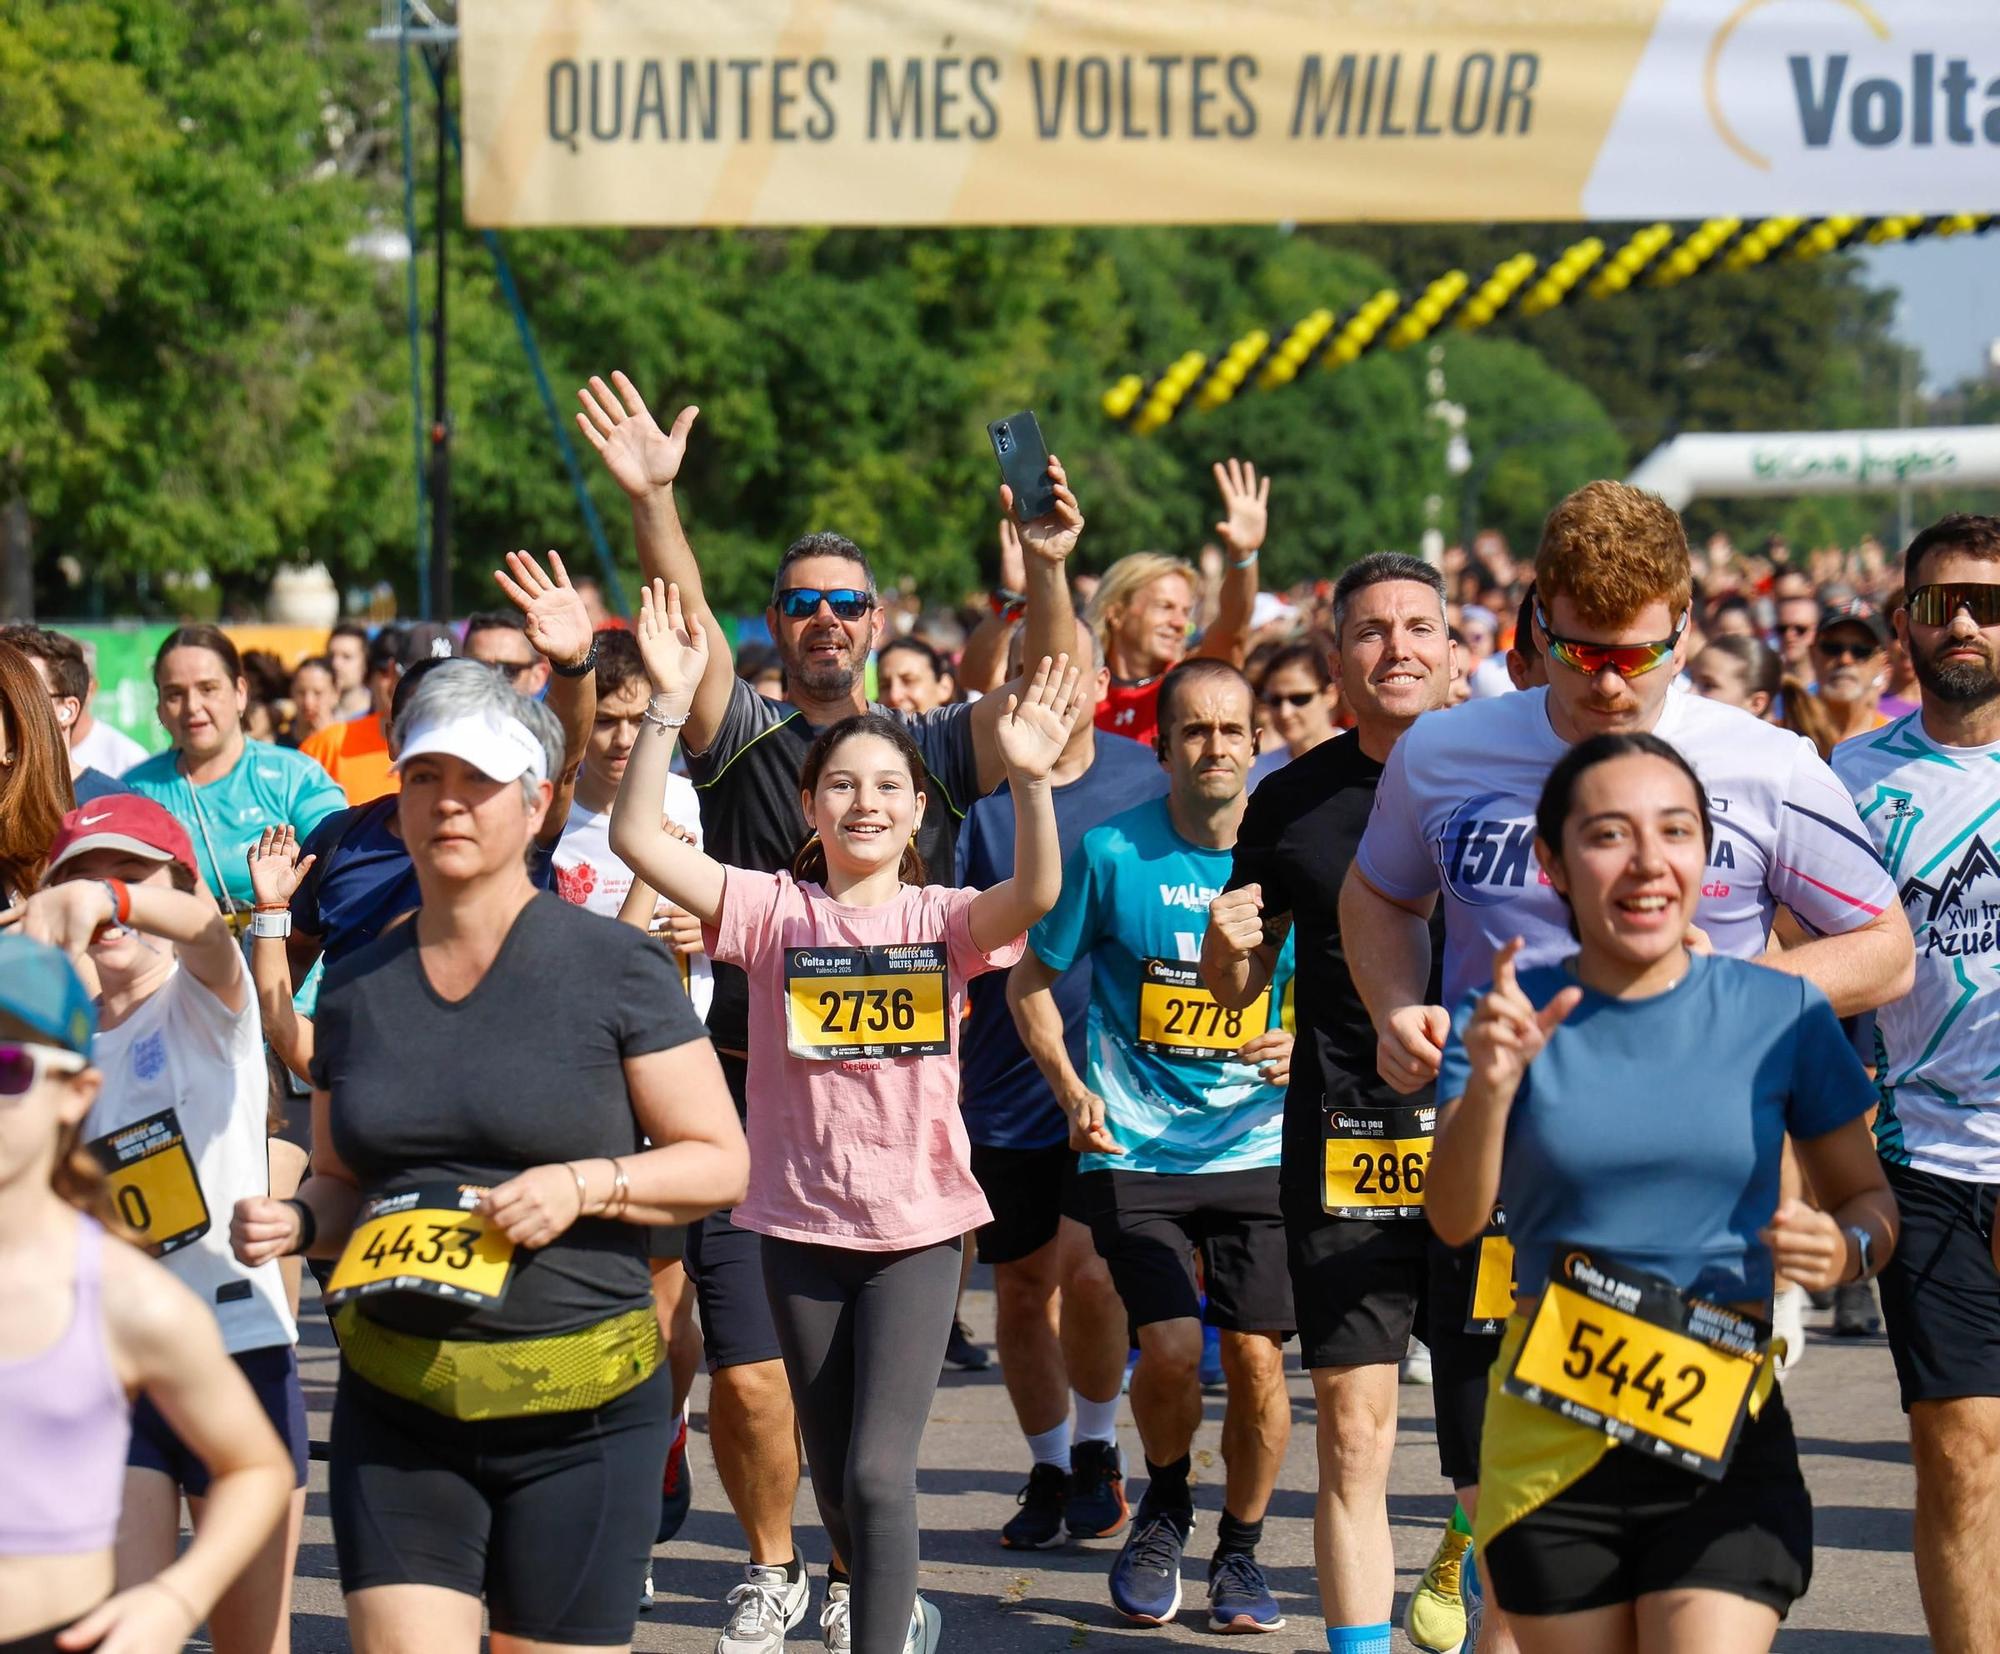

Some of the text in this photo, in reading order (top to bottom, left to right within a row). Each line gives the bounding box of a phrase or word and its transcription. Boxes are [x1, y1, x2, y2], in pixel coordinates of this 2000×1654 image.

[548, 33, 1541, 154] QUANTES MÉS VOLTES MILLOR
[1947, 900, 2000, 931] XVII tr
[801, 956, 852, 968] Volta a peu
[819, 988, 915, 1033] 2736
[1163, 999, 1244, 1038] 2778
[1338, 1117, 1360, 1128] Volta
[1353, 1152, 1432, 1195] 286
[361, 1224, 483, 1269] 4433
[1562, 1318, 1707, 1427] 5442
